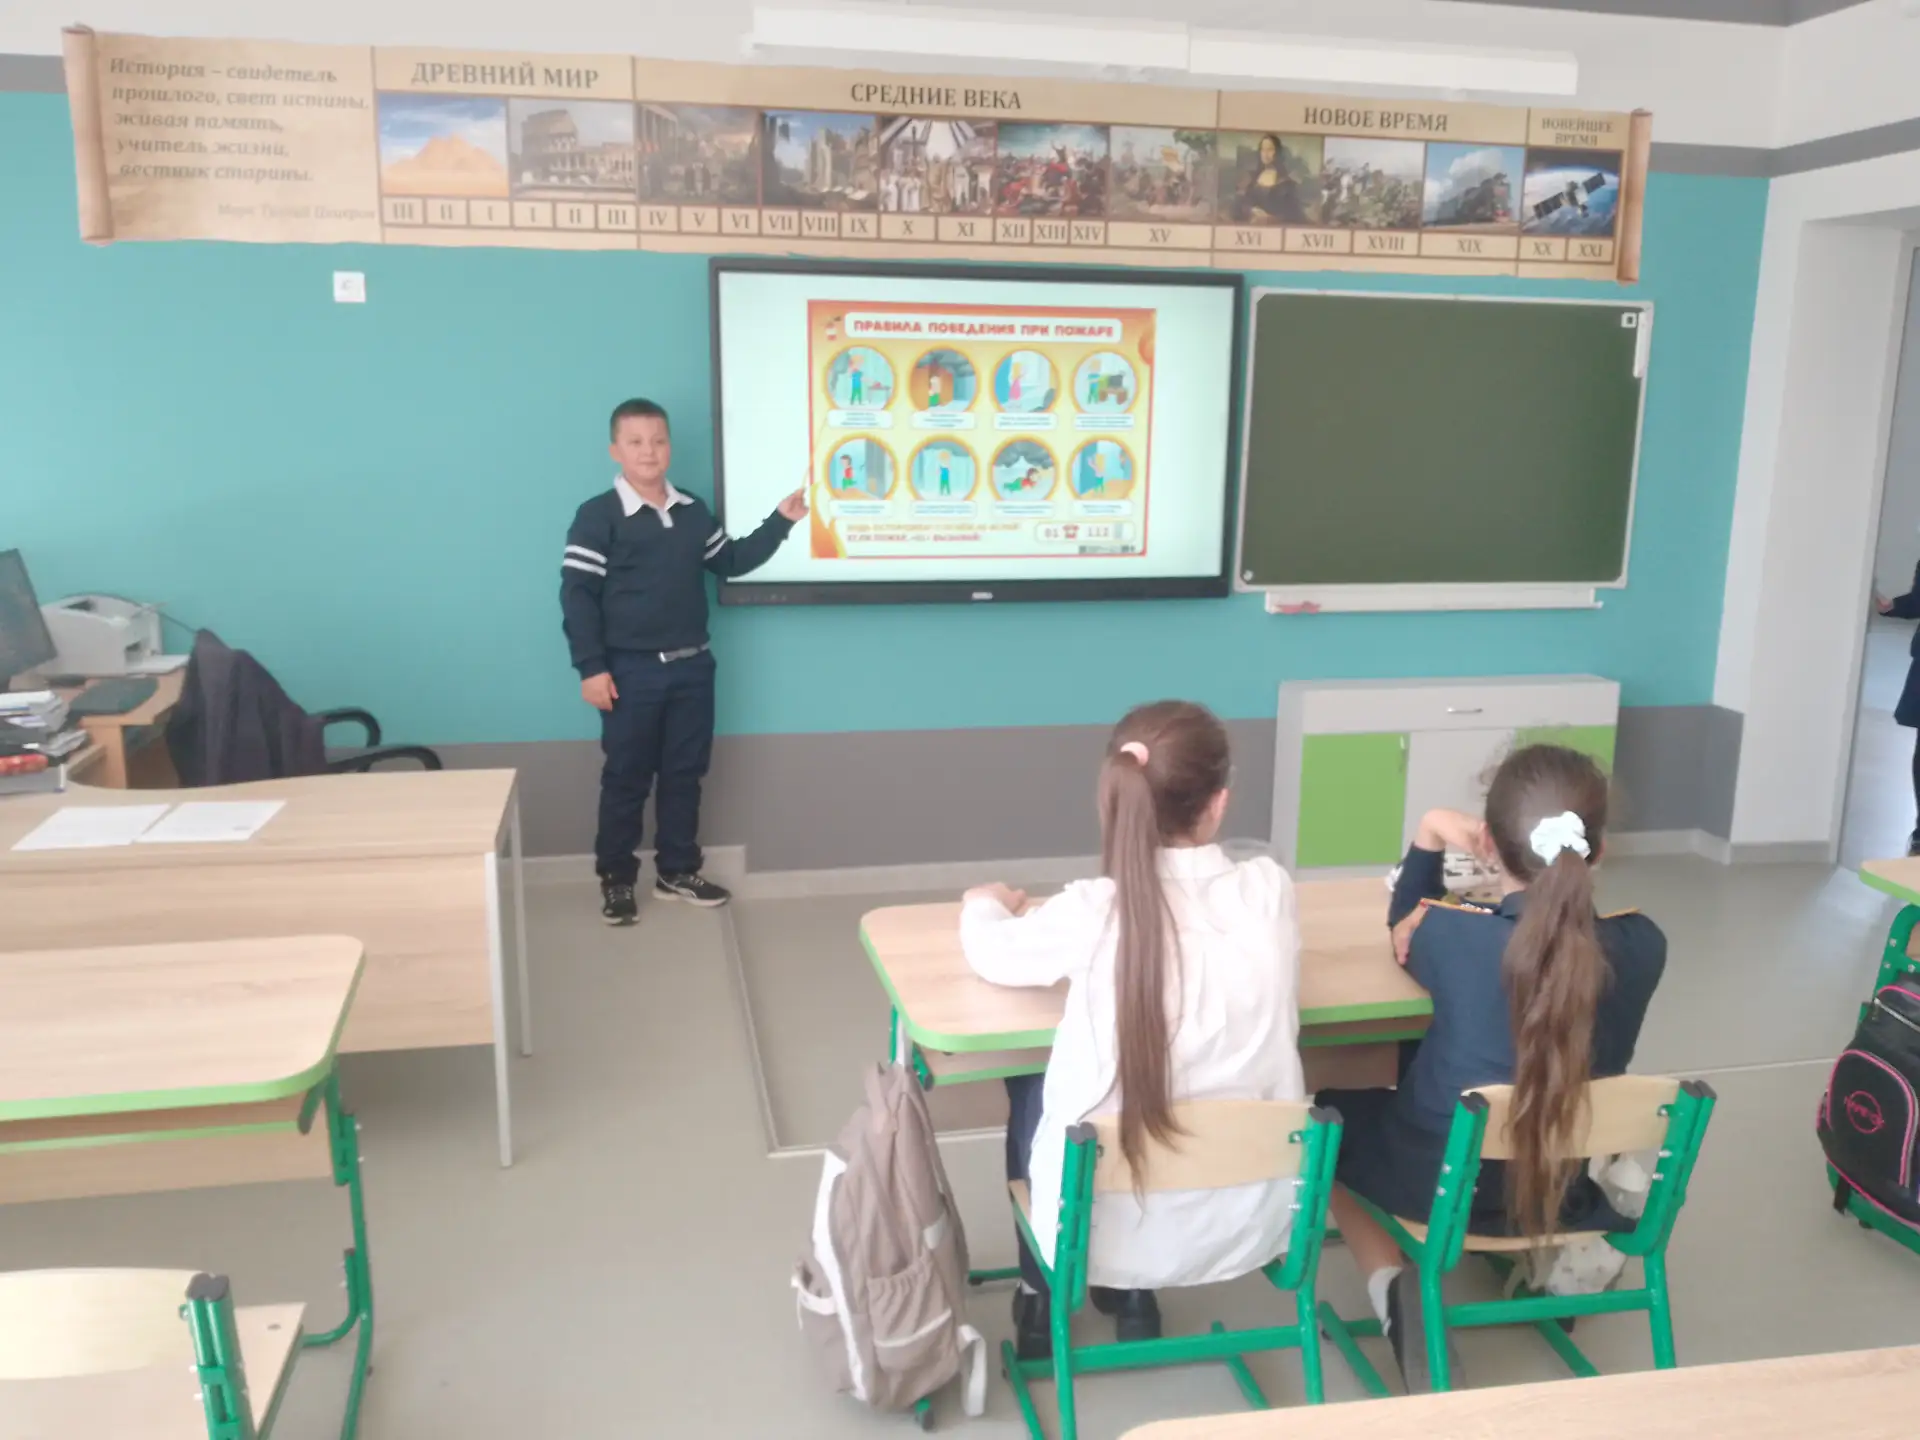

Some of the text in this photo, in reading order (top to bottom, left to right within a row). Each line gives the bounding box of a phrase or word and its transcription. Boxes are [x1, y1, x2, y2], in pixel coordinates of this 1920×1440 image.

[110, 57, 206, 80] История
[226, 64, 338, 83] свидетель
[411, 61, 600, 89] ДРЕВНИЙ МИР
[112, 85, 221, 106] прошлого,
[226, 91, 277, 106] свет
[851, 83, 1023, 110] СРЕДНИЕ ВЕКА
[114, 111, 284, 133] живая память,
[1303, 107, 1449, 132] НОВОЕ ВРЕМЯ
[1542, 117, 1615, 133] НОВЕЙШЕЕ
[116, 137, 208, 155] учитель
[1555, 133, 1599, 147] ВРЕМЯ
[120, 164, 314, 184] вестник старины.
[393, 202, 1604, 258] III II I I II III IV V VI VII VIII IX X XI XII XIII XIV XV XVI XVII XVIII XIX XX XXI
[854, 320, 1114, 338] ПРАВИЛА ПОВЕДЕНИЯ ПРИ ПОЖАРЕ
